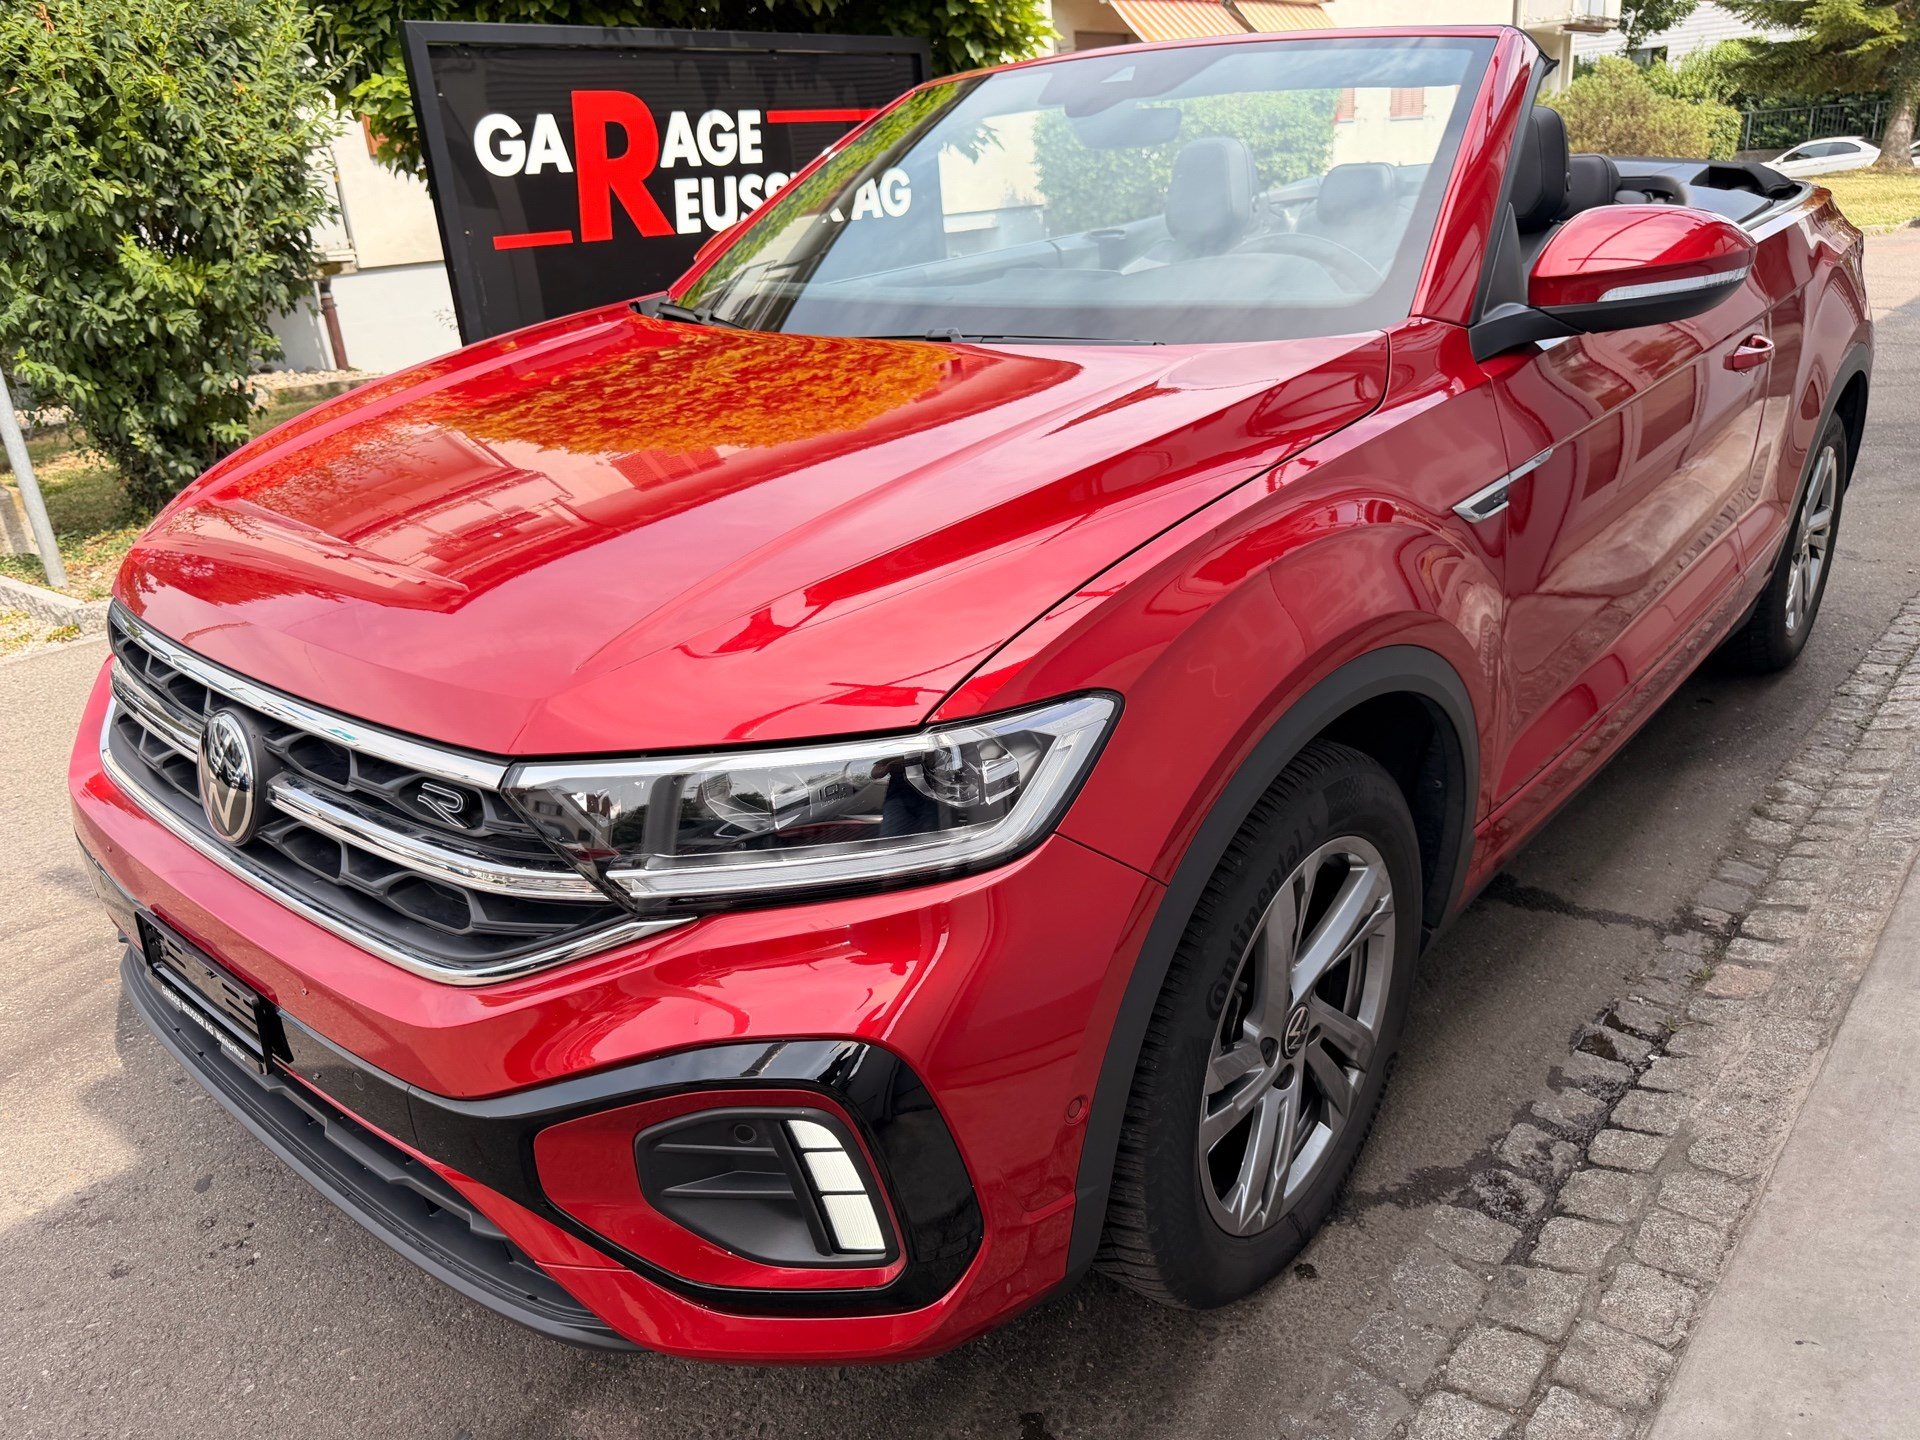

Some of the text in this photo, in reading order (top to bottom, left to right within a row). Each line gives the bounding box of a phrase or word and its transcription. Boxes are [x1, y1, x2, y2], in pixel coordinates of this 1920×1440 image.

[473, 90, 763, 243] GARAGE
[850, 168, 912, 222] AG
[1205, 829, 1304, 1021] Continental
